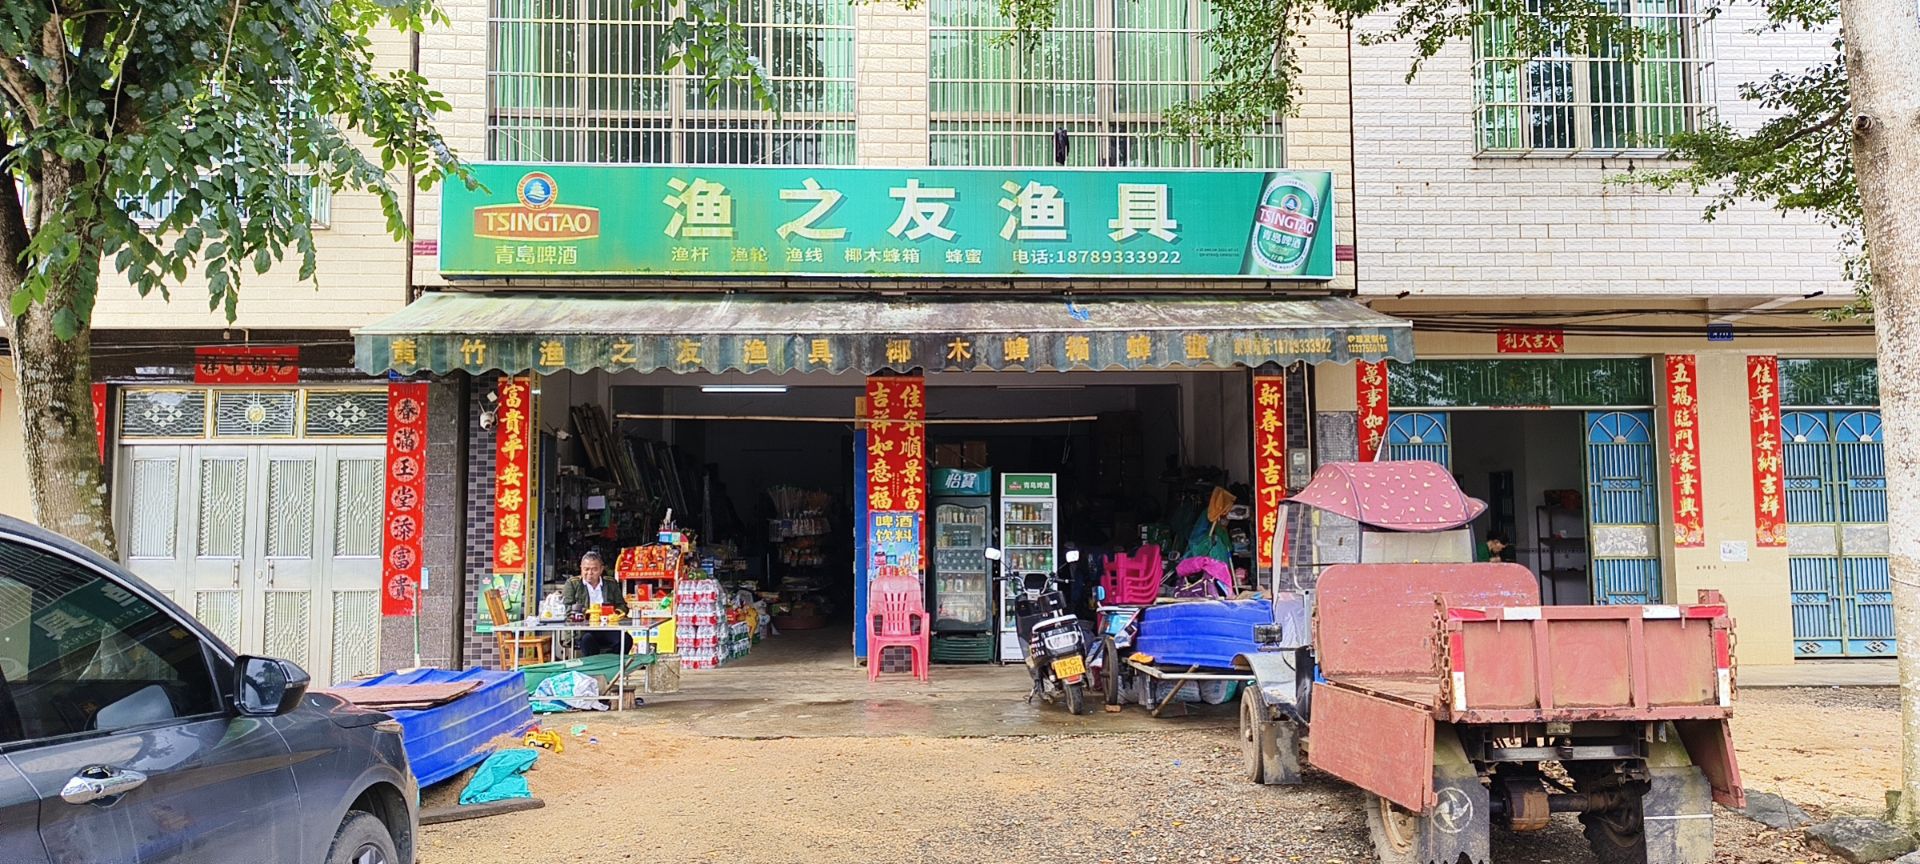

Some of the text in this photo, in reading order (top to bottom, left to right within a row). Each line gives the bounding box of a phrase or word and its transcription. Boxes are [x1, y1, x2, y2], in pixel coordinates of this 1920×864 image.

[662, 176, 1178, 243] 渔之友渔具
[482, 211, 591, 233] TSINGTAO
[1260, 209, 1314, 233] TSINGTAO
[495, 245, 578, 265] 青島啤酒
[671, 246, 710, 263] 渔杆
[786, 247, 824, 263] 渔线
[845, 247, 920, 264] 椰木蜂箱
[945, 248, 983, 265] 蜂蜜
[1013, 249, 1182, 266] 电话:18789333922
[1671, 363, 1698, 517] 五福臨門家業興
[1752, 363, 1780, 516] 佳年平安納吉祥
[876, 515, 913, 528] 啤酒
[876, 529, 913, 543] 饮料
